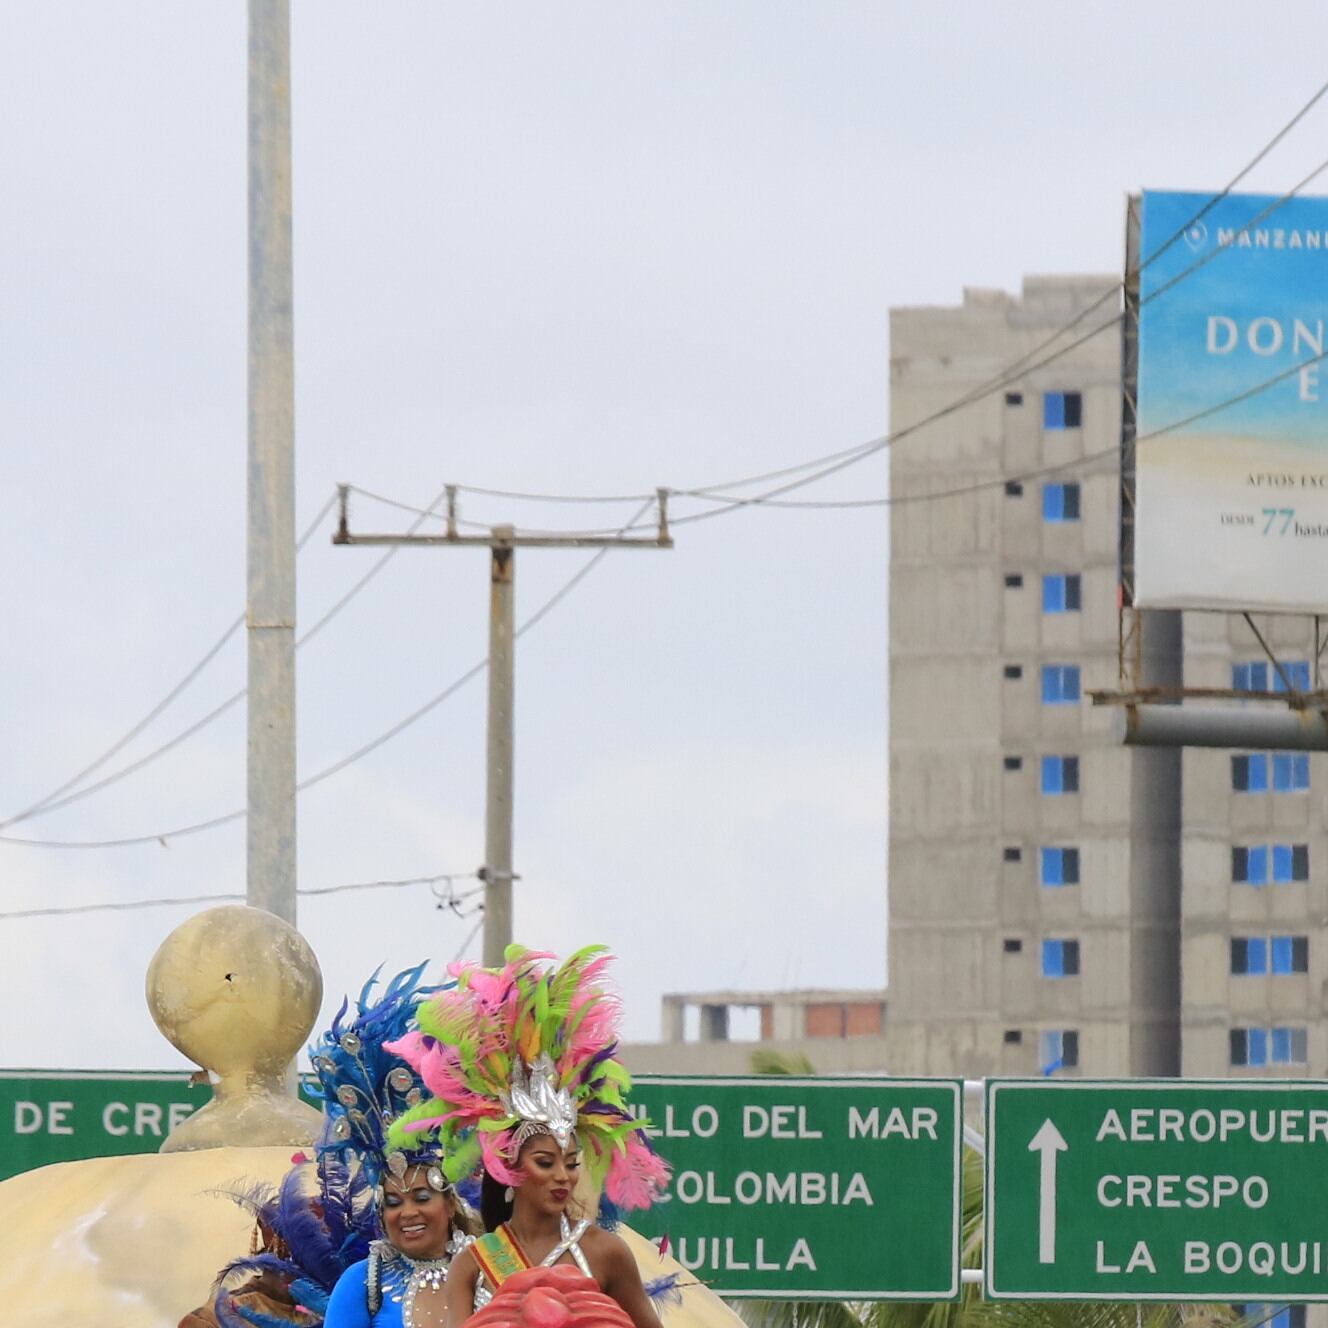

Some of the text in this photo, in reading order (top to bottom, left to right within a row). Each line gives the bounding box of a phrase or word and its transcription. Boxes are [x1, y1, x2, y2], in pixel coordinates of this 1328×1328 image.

[1247, 473, 1295, 488] APTOS
[1262, 507, 1296, 535] 77
[14, 1102, 74, 1135] DE
[102, 1102, 194, 1136] CRE
[742, 1105, 822, 1139] DEL
[848, 1106, 938, 1140] MAR
[1096, 1175, 1269, 1209] CRESPO
[1095, 1241, 1157, 1274] LA
